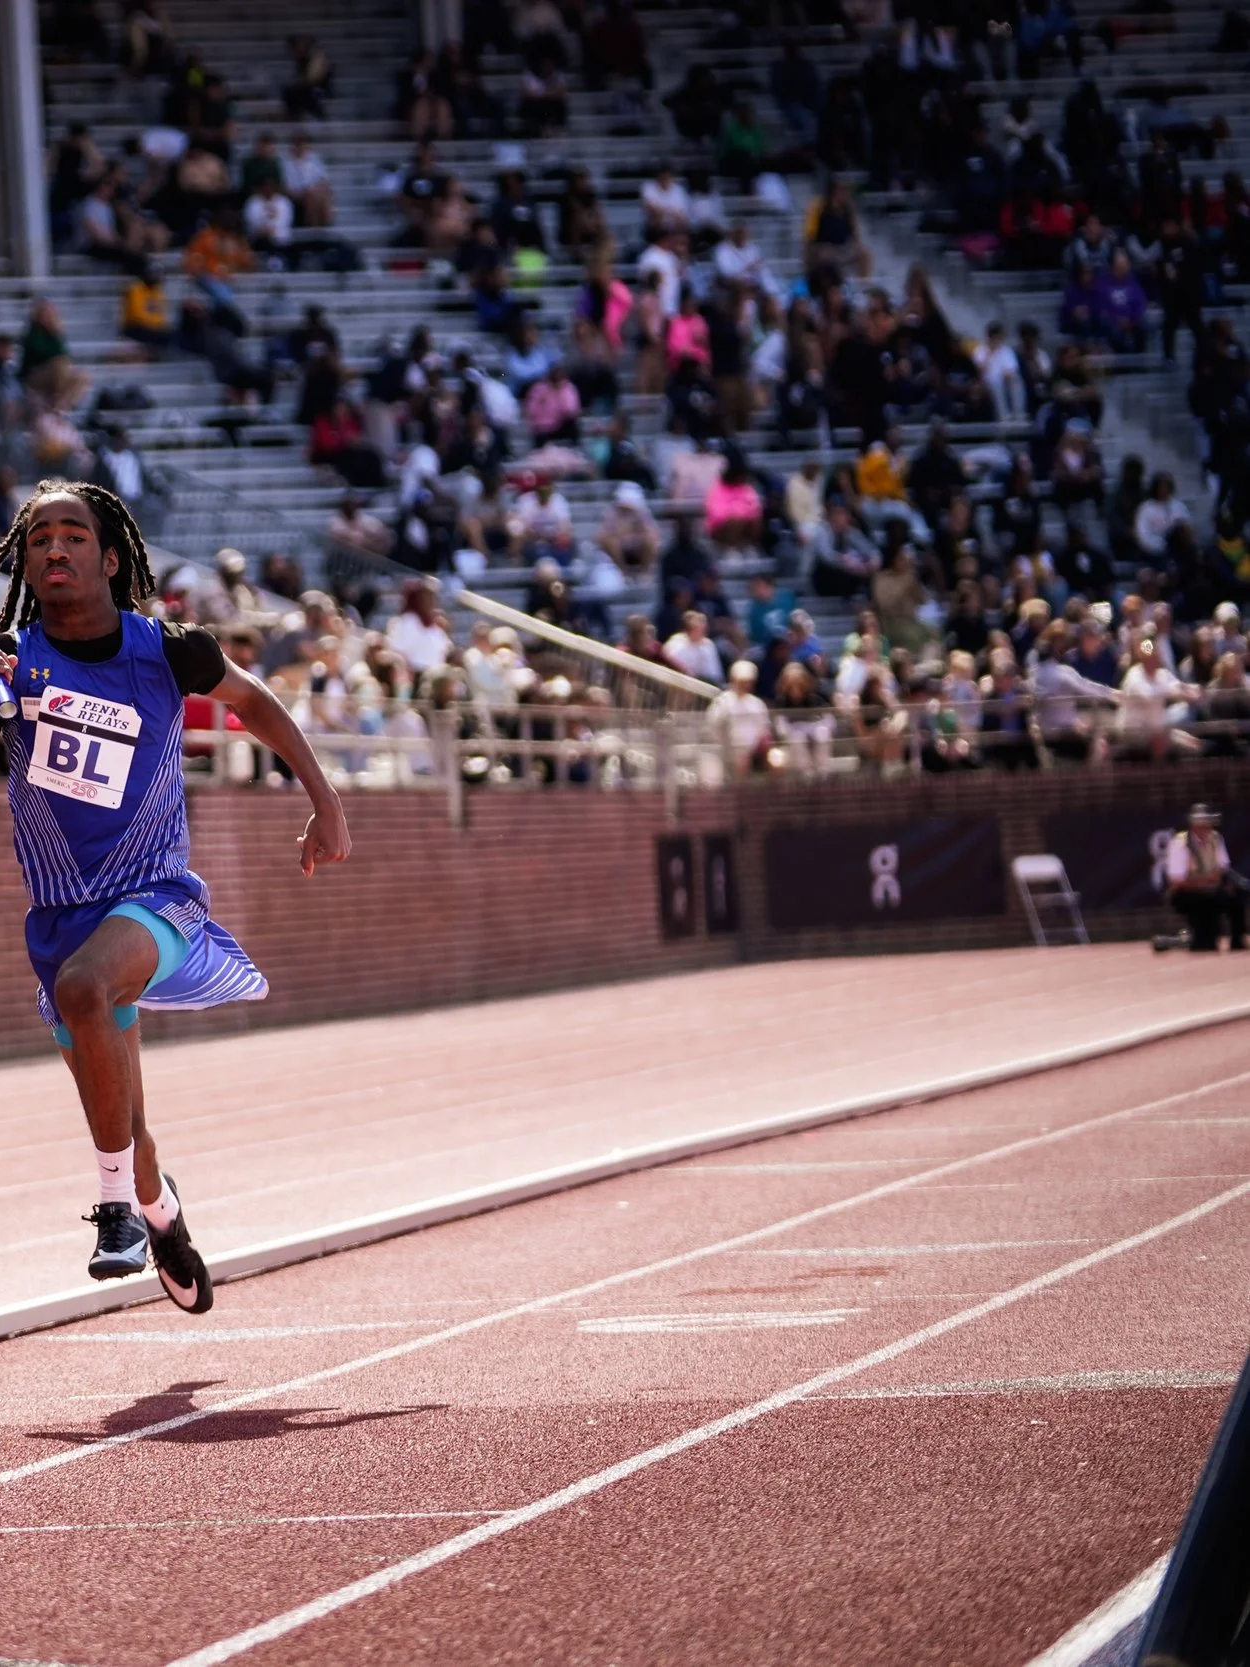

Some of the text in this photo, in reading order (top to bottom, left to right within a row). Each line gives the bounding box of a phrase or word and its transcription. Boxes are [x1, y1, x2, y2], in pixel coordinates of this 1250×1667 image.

[82, 701, 121, 717] PENN
[77, 710, 129, 730] RELAYS
[46, 730, 110, 785] BL
[71, 781, 98, 799] 250
